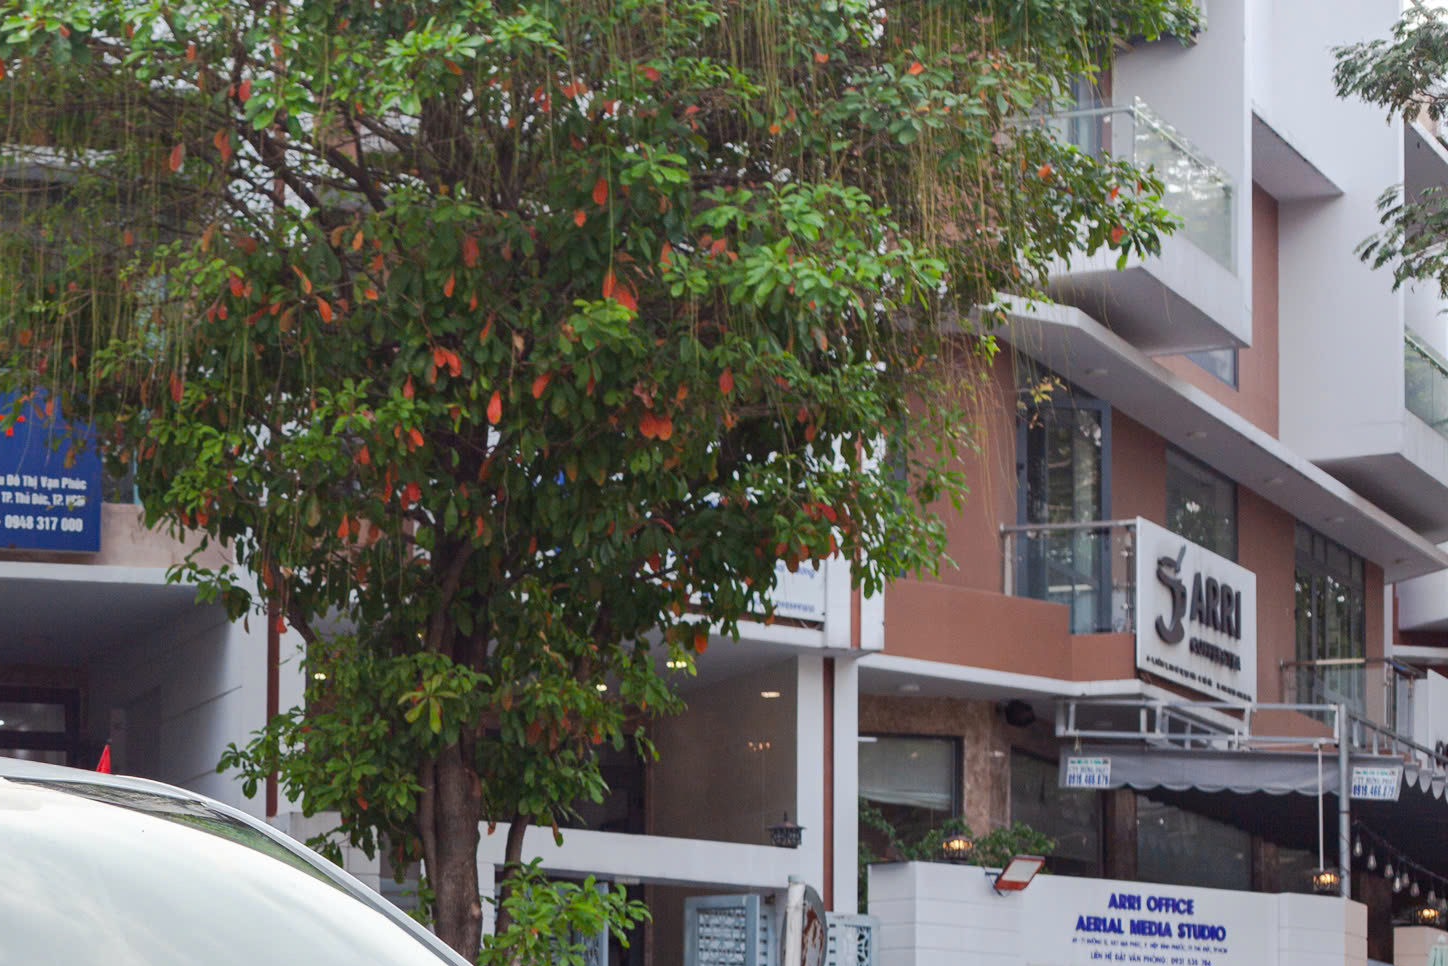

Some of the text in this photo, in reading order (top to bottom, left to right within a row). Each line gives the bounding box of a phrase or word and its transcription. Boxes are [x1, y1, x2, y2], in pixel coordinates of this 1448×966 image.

[36, 516, 58, 531] 317
[1189, 571, 1241, 640] ARRI
[1108, 892, 1195, 915] ARRI OFFICE
[1075, 915, 1227, 942] AERIAL MEDIA STUDIO
